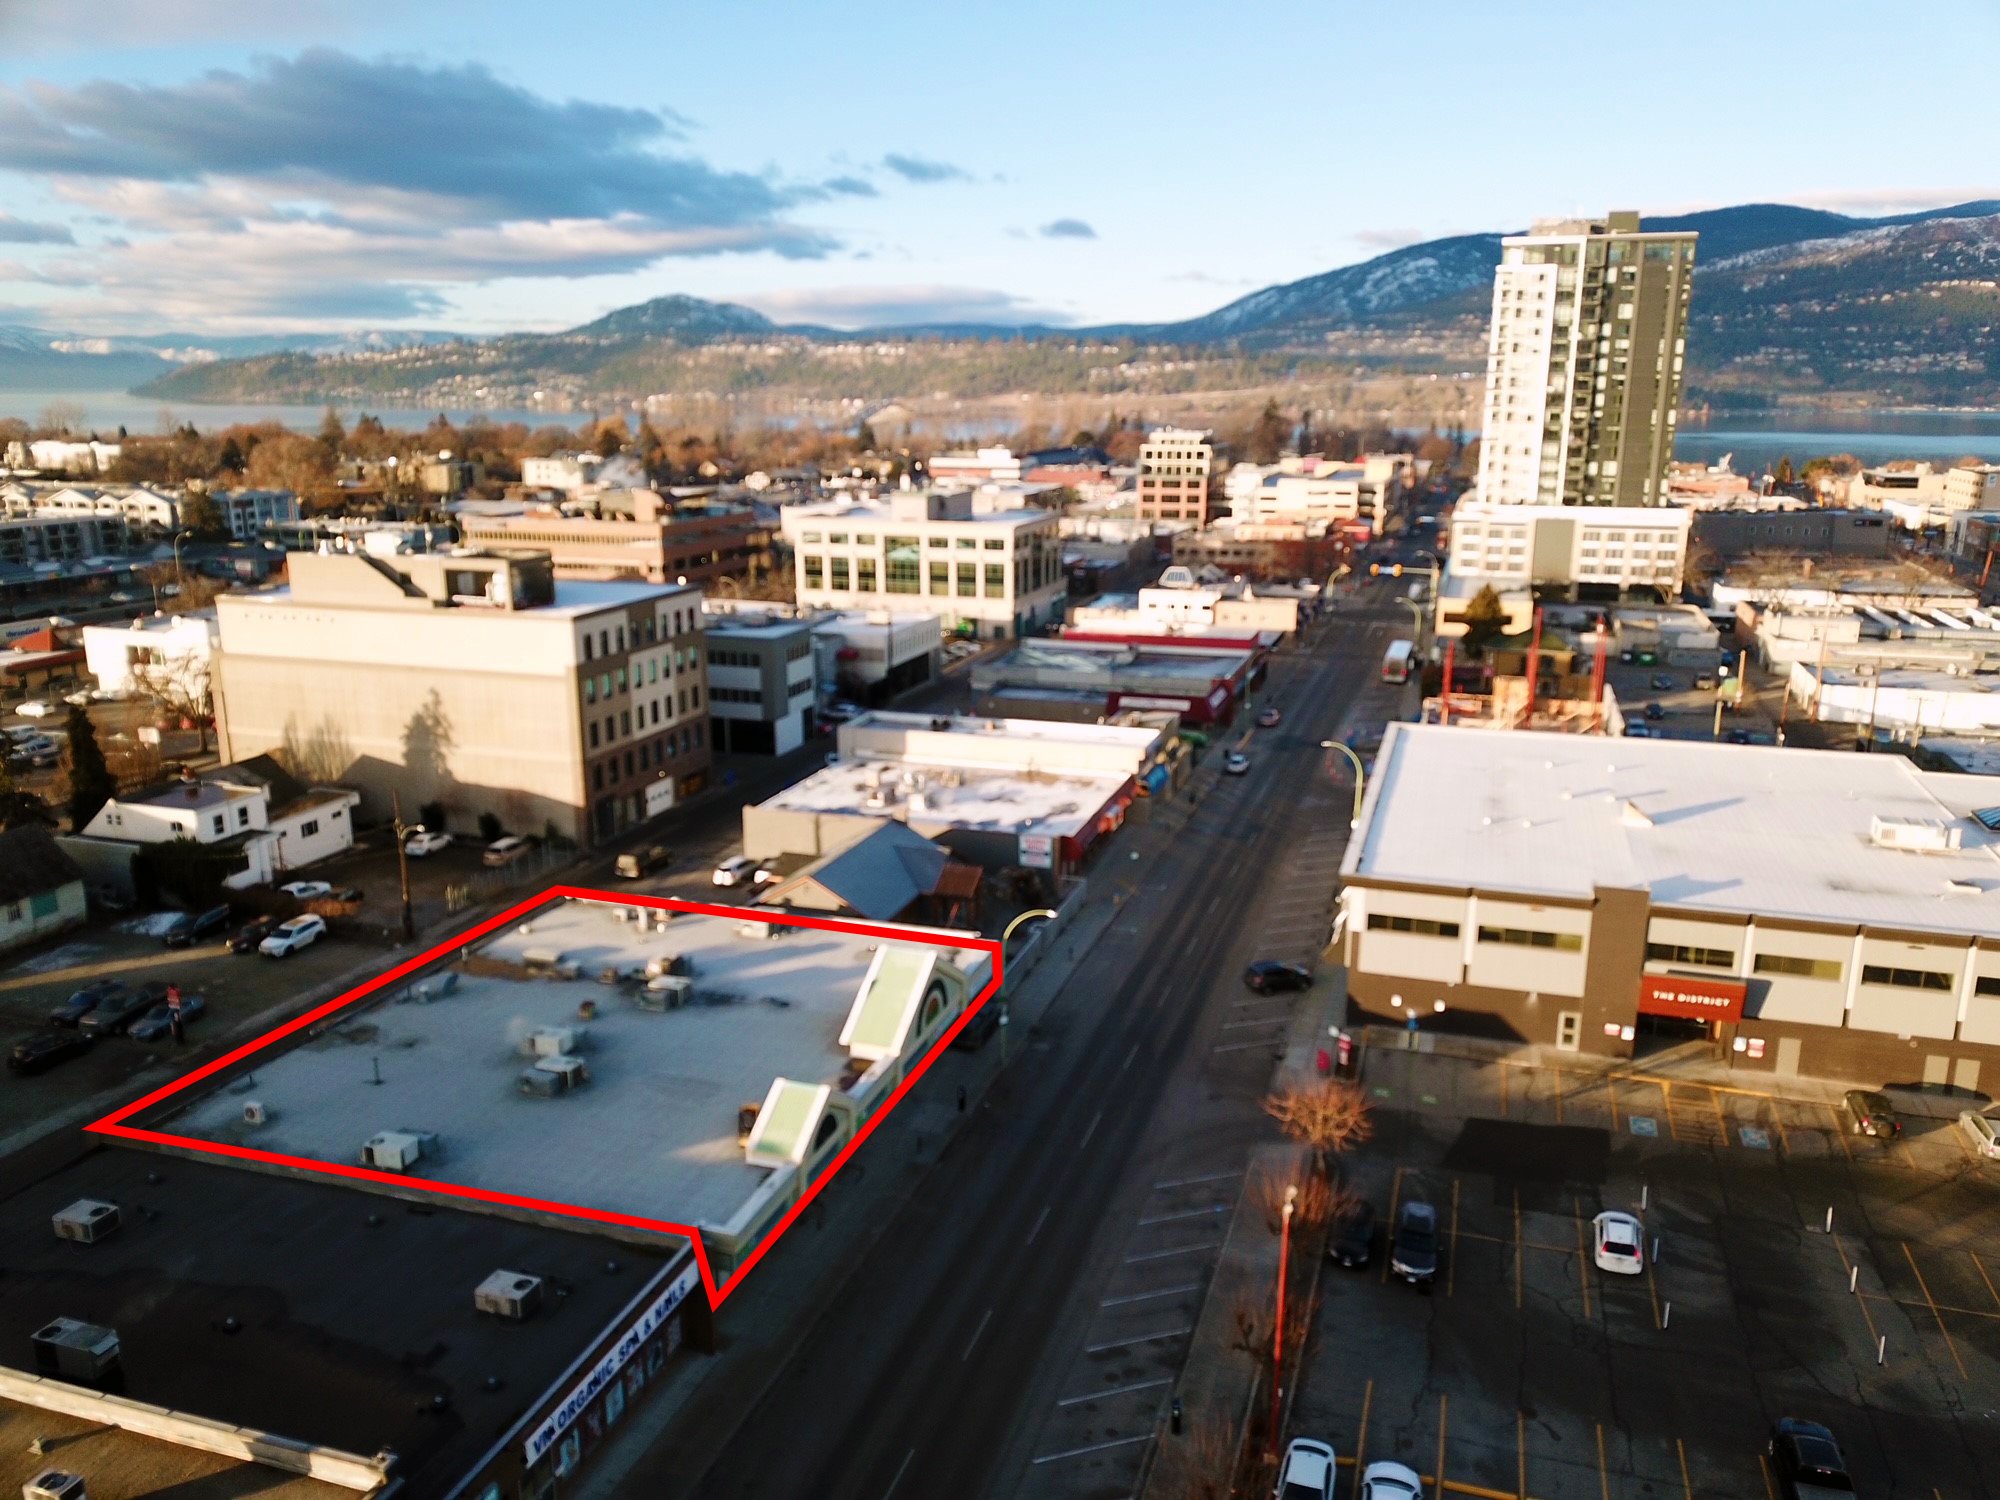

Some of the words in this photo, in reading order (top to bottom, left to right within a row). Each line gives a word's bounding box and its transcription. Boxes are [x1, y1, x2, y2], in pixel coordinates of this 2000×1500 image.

[1653, 990, 1675, 1001] THE
[1677, 993, 1730, 1007] DISTRICT
[558, 1358, 613, 1428] ORGANIC
[618, 1332, 640, 1362] SPA
